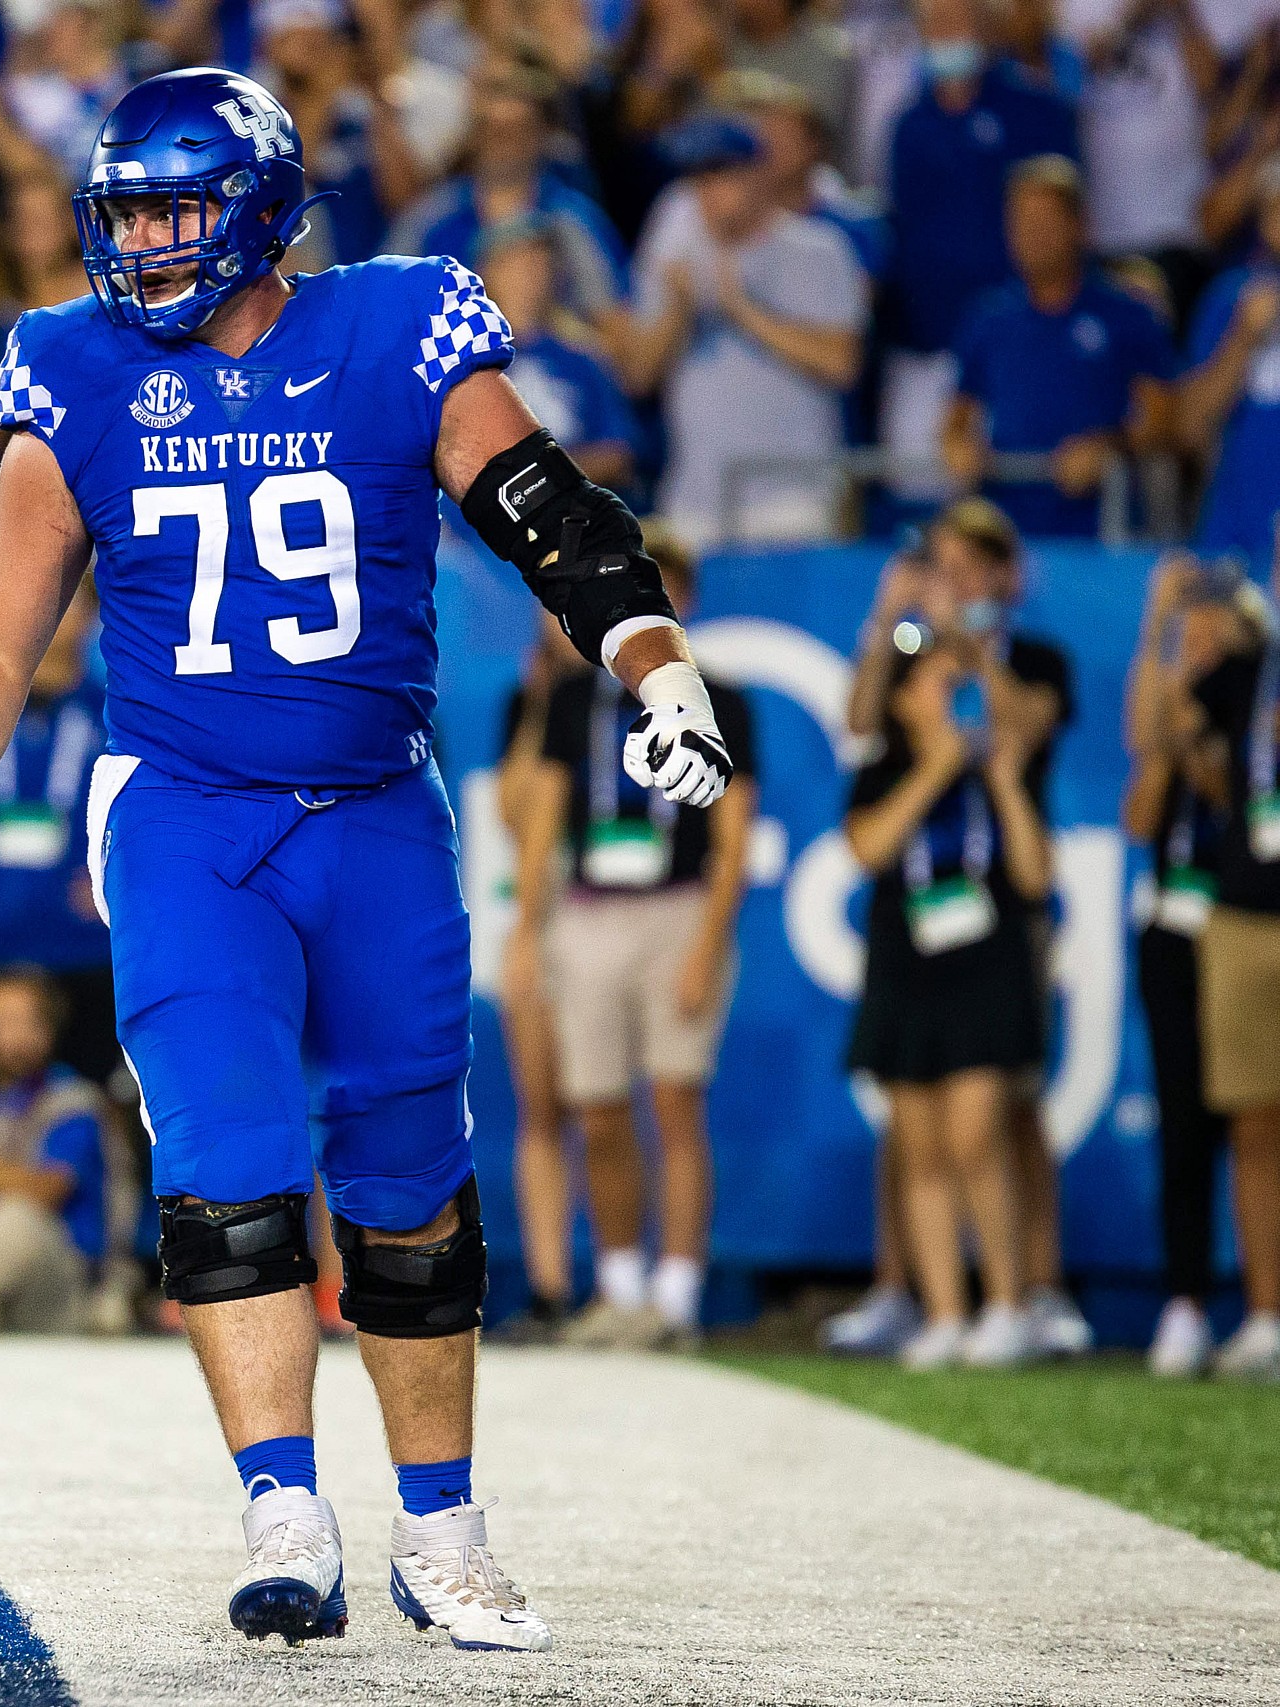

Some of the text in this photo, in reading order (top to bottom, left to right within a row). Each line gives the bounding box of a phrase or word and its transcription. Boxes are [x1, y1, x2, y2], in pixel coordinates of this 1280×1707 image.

[143, 373, 183, 414] SEC
[216, 368, 250, 398] UK
[134, 410, 186, 428] GRADUATE
[140, 431, 333, 473] KENTUCKY
[132, 469, 361, 675] 79
